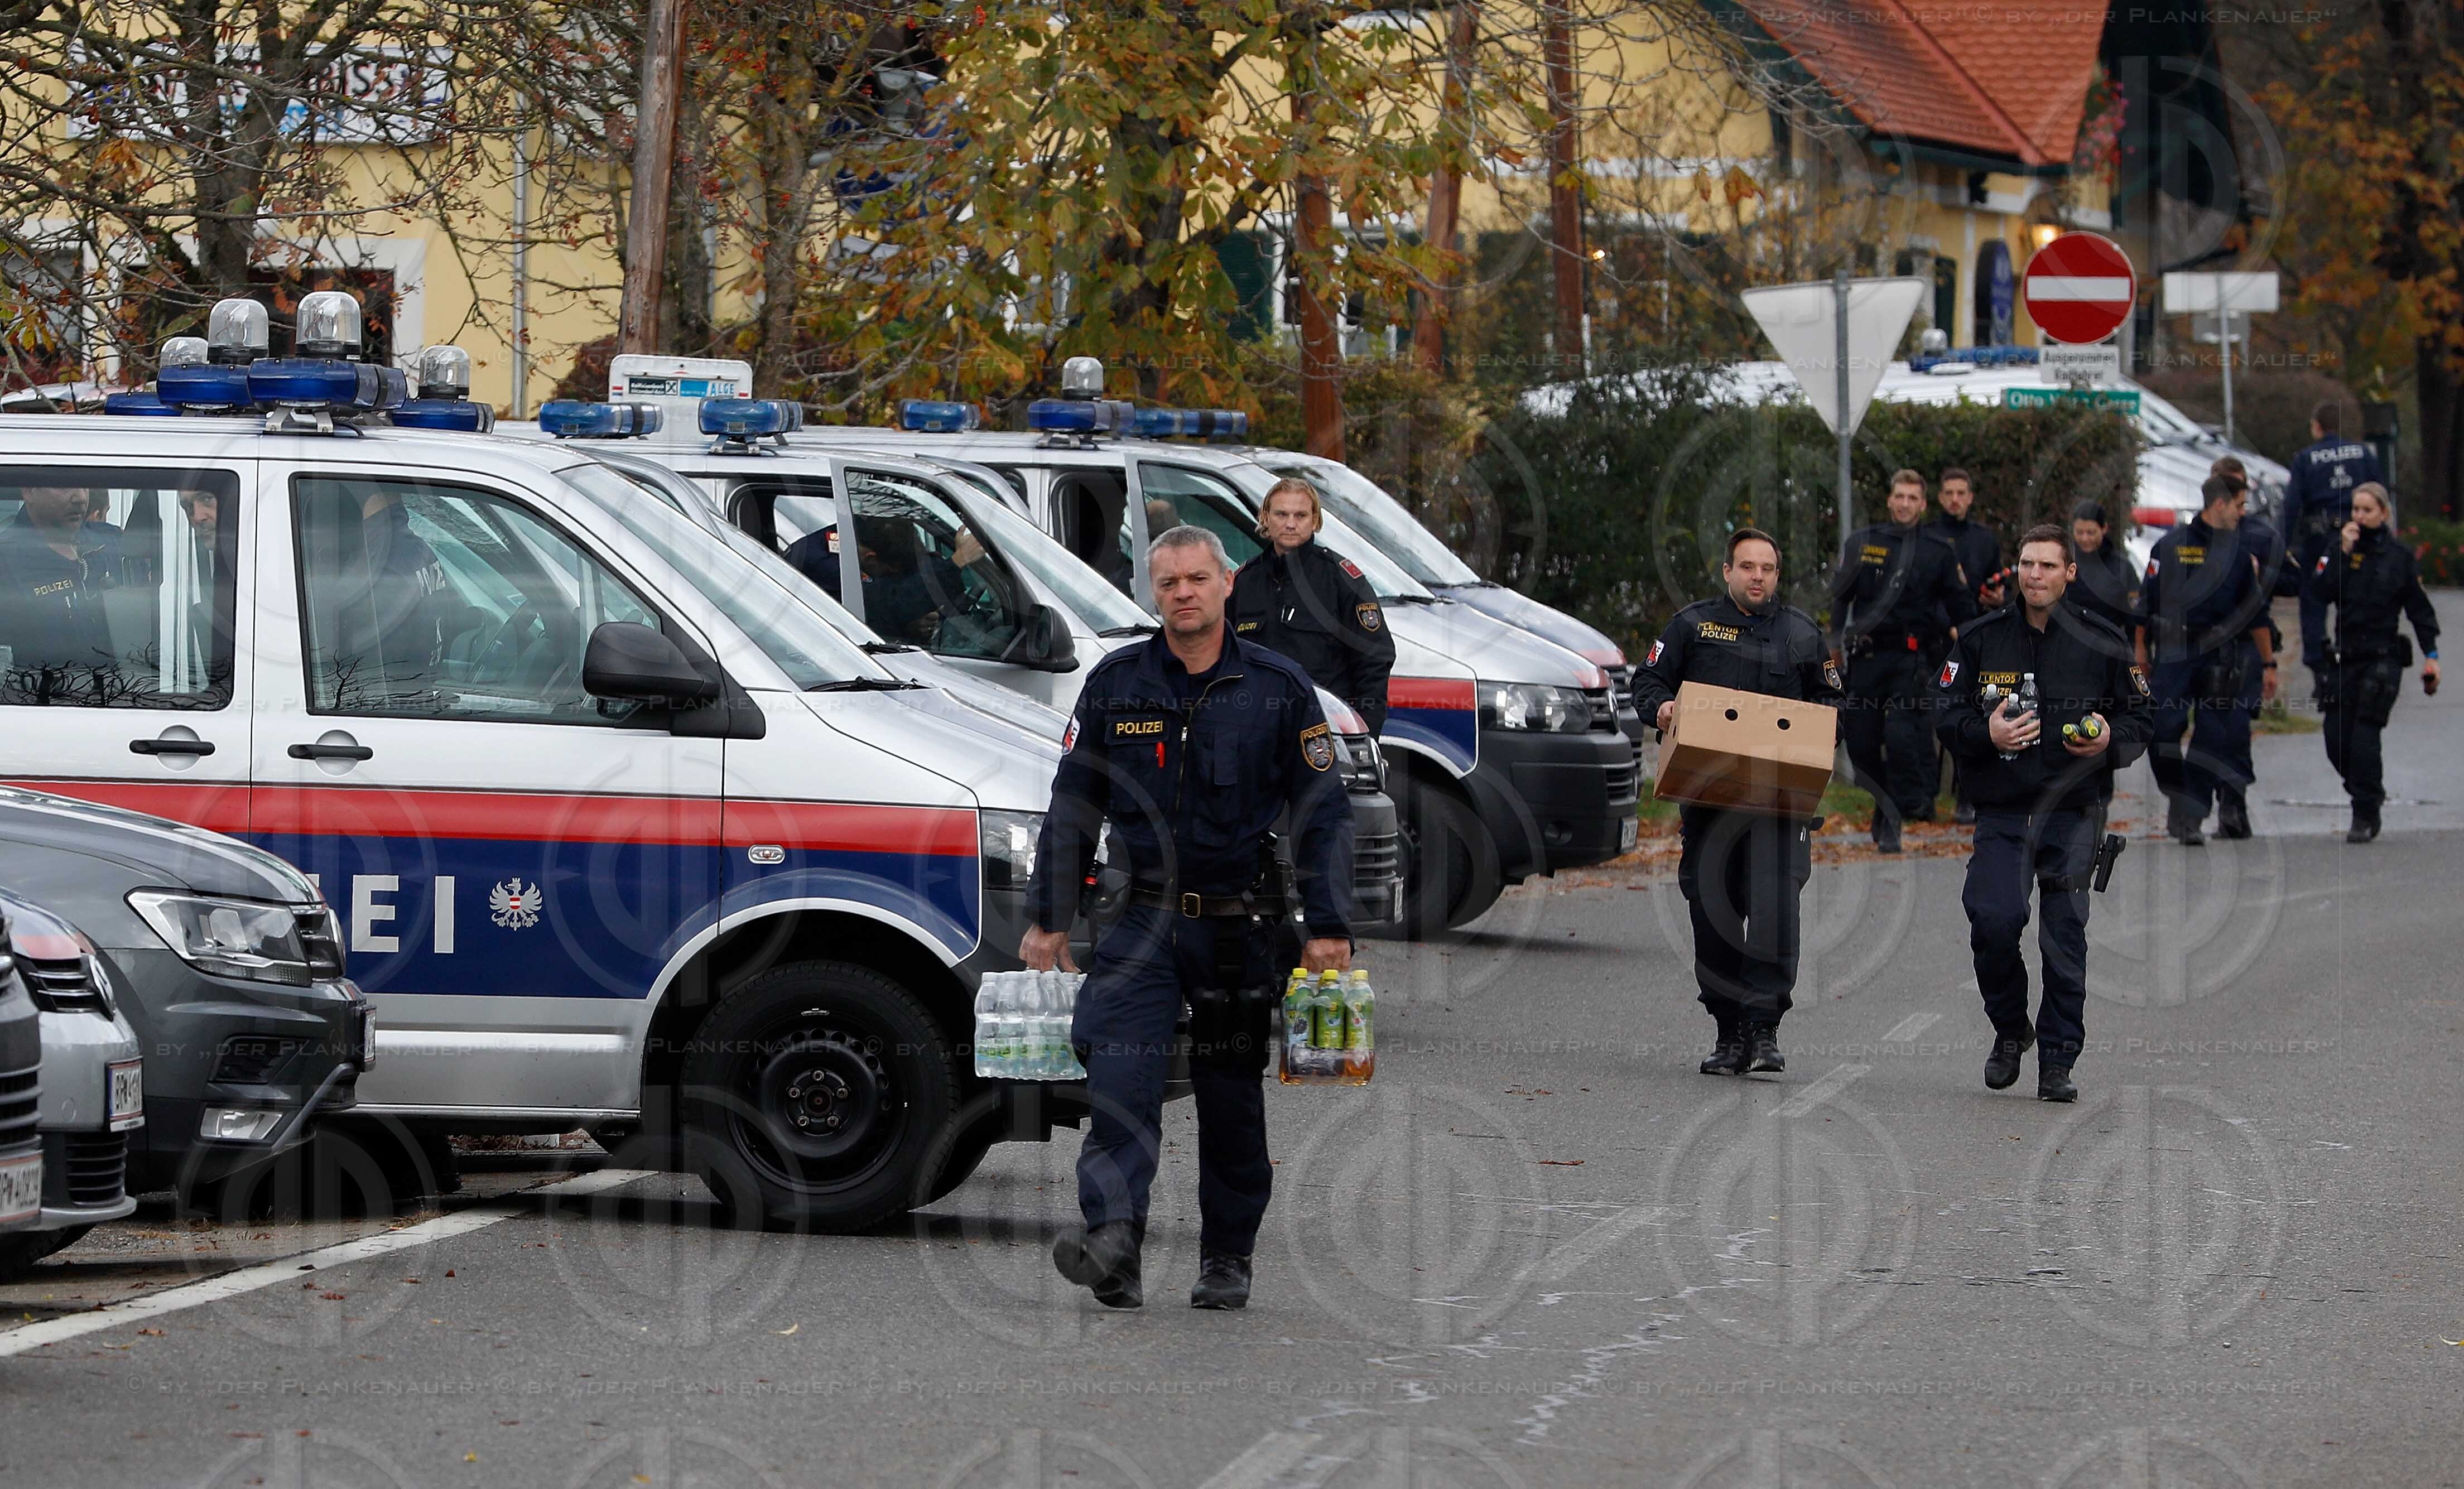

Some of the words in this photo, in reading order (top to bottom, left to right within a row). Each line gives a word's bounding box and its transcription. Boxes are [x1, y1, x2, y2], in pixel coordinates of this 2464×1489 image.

[33, 579, 74, 596] POLIZEI
[1701, 630, 1736, 642] POLIZEI
[1981, 687, 2012, 696] PIZEI
[1116, 720, 1163, 735] POLIZEI
